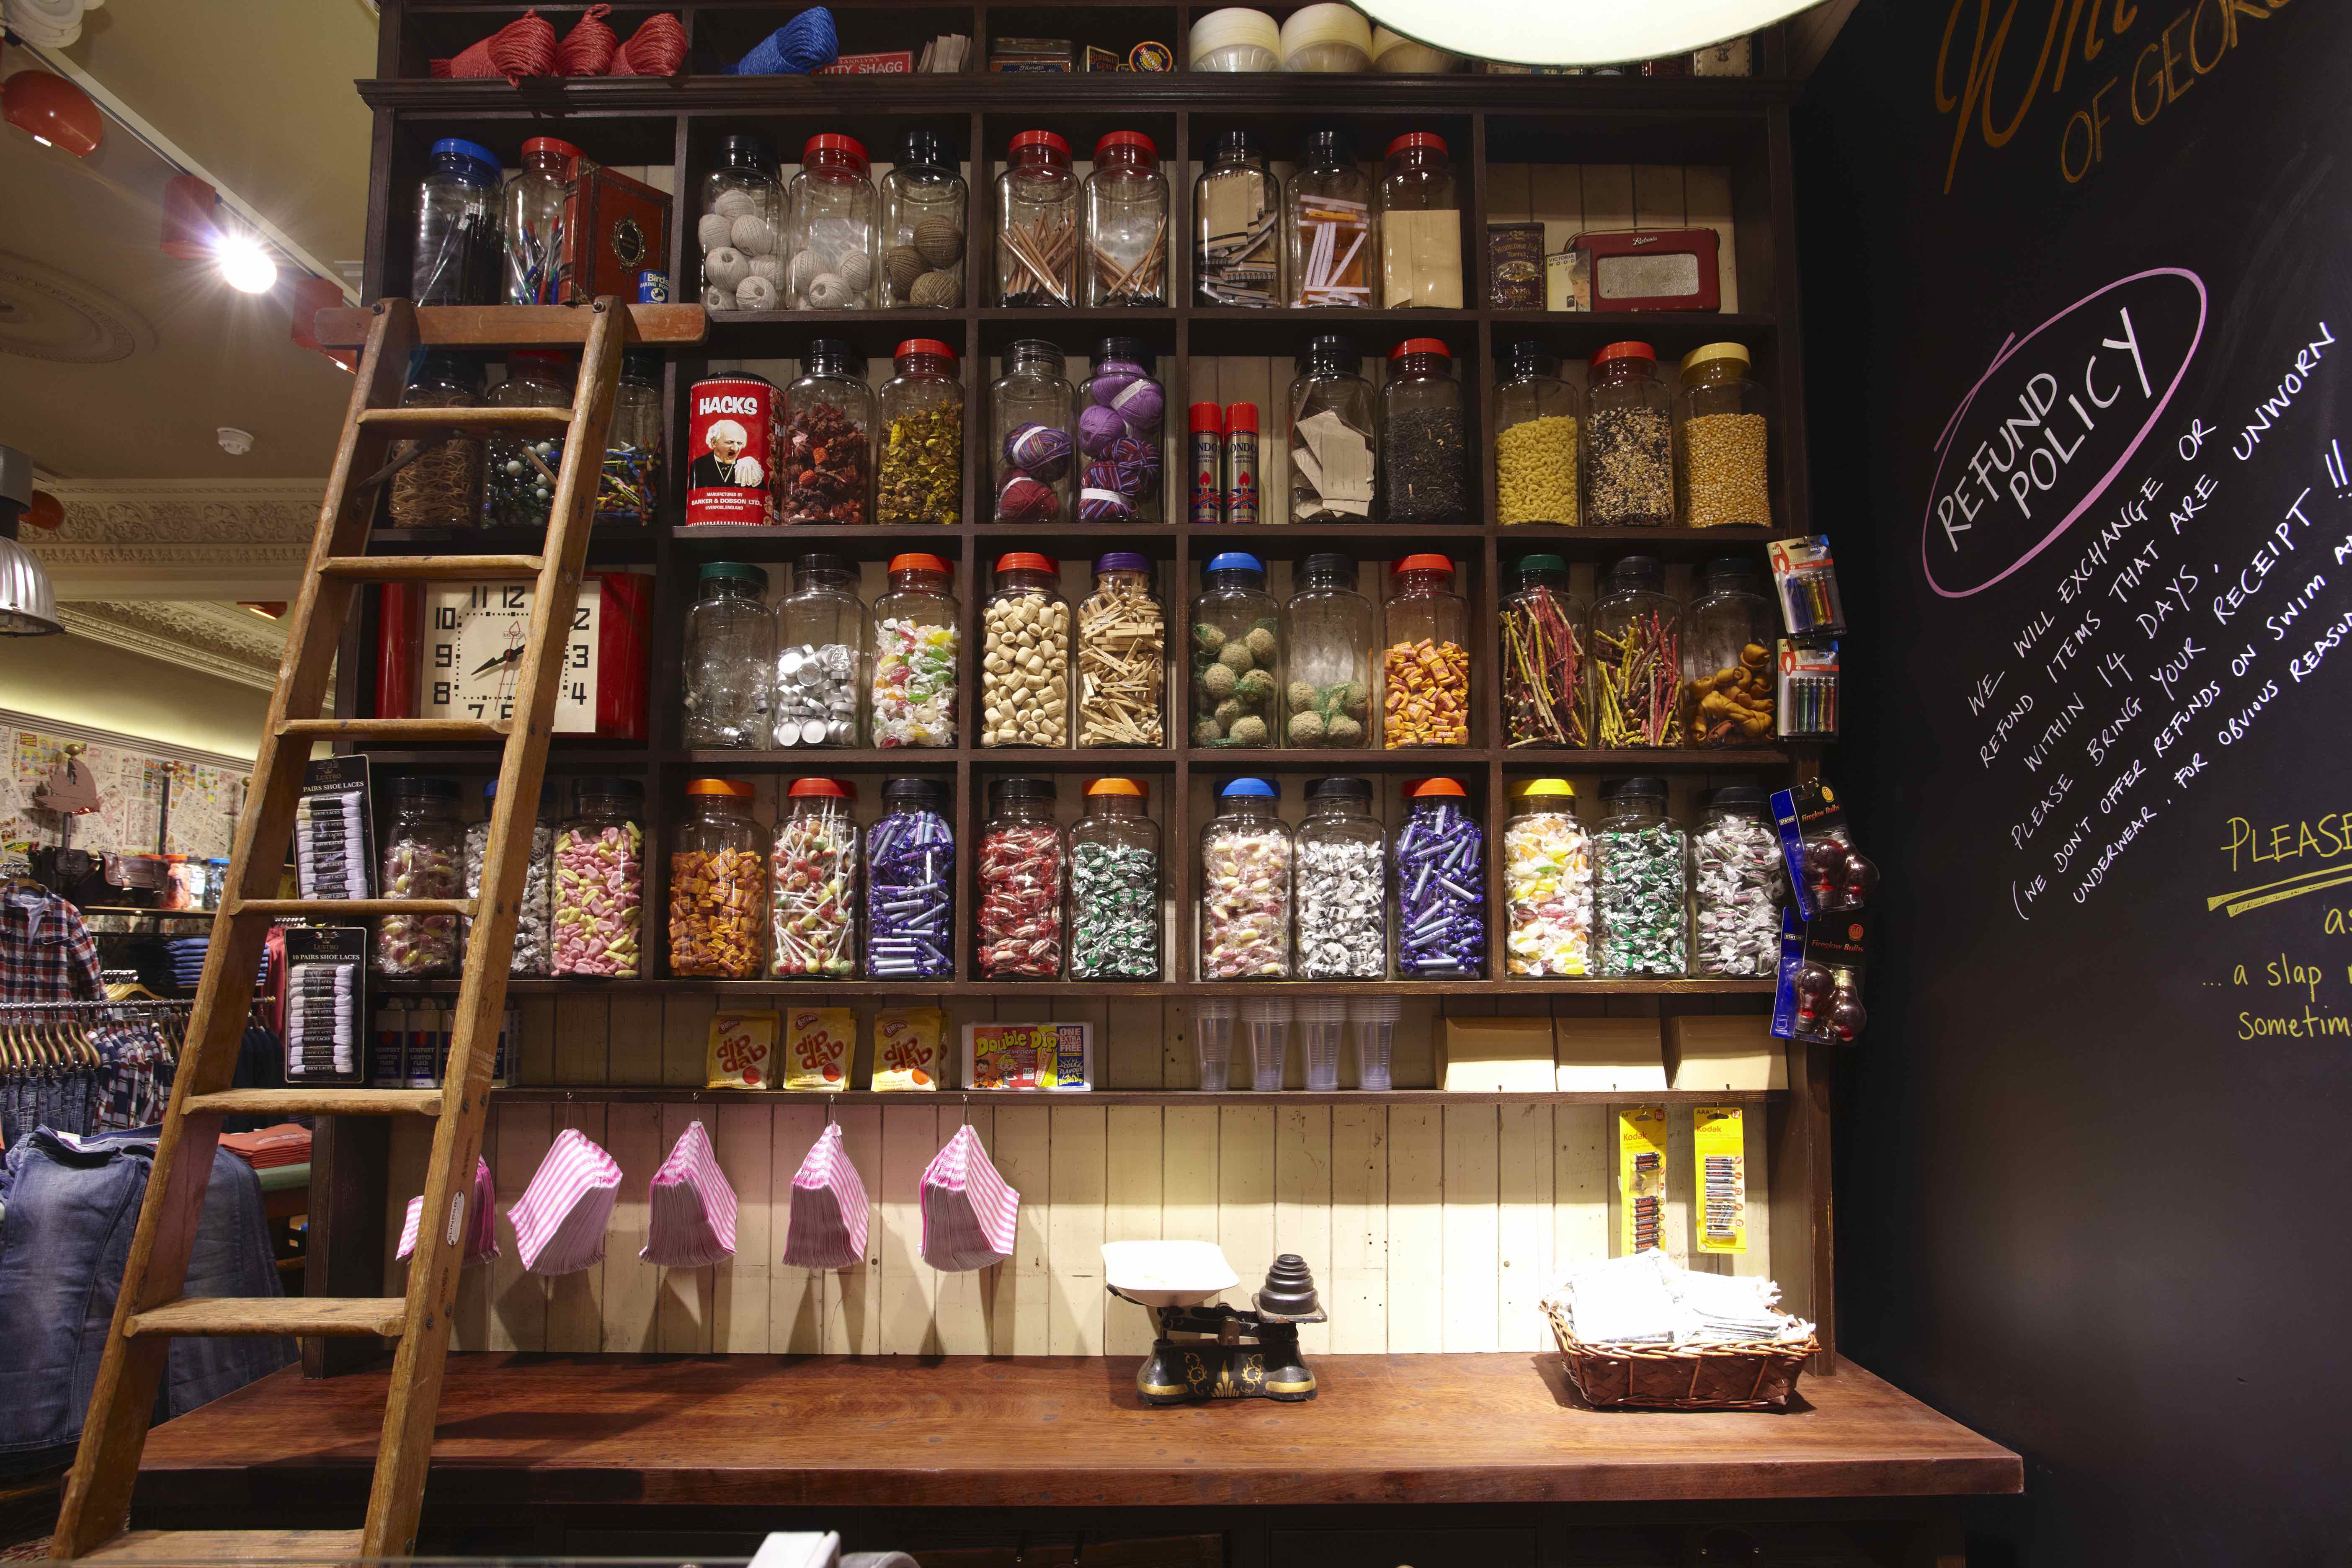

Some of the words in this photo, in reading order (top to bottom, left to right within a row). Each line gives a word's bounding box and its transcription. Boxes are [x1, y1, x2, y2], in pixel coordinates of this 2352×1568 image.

[820, 65, 853, 74] ITTY
[859, 61, 903, 74] SHAGG
[1140, 48, 1164, 72] WALNUT
[2061, 76, 2118, 183] OF
[1633, 236, 1658, 246] Roberts
[1548, 254, 1575, 263] VICTORIA
[699, 395, 758, 415] HACKS
[2009, 307, 2151, 519] POLICY
[1937, 373, 2058, 552] REFUND
[1980, 695, 2033, 769] REFUND
[2046, 610, 2101, 683] ITEMS
[2108, 539, 2160, 603] THAT
[2169, 474, 2218, 535] ARE
[2232, 321, 2336, 461] UNWORN
[1968, 671, 2005, 717] WE
[2013, 611, 2055, 658] WILL
[2057, 477, 2164, 604] EXCHANGE
[2179, 418, 2217, 461] OR
[472, 586, 487, 608] 11
[502, 586, 526, 609] 12
[435, 607, 456, 630] 10
[573, 607, 590, 631] 2
[435, 644, 452, 667] 9
[572, 645, 588, 668] 3
[2011, 774, 2073, 850] PLEASE
[2086, 696, 2143, 766] BRING
[2149, 637, 2205, 701] YOUR
[2213, 487, 2311, 625] RECEIPT
[433, 681, 450, 705] 8
[571, 682, 587, 705] 4
[2024, 693, 2085, 773] WITHIN
[2097, 652, 2133, 688] 14
[2053, 816, 2092, 873] DON'T
[2100, 759, 2147, 815] OFFER
[2154, 680, 2221, 758] REFUNDS
[2231, 644, 2257, 677] ON
[2266, 574, 2326, 641] SWIM
[2174, 753, 2208, 789] FOR
[2218, 679, 2279, 745] OBVIOUS
[1823, 789, 1831, 798] 60
[1801, 810, 1825, 823] Fireglow
[1825, 804, 1841, 815] Bulbs
[1850, 926, 1861, 935] 60
[1811, 939, 1843, 951] Fireglow
[1844, 943, 1864, 952] Bulbs
[2267, 953, 2322, 1003] slap
[717, 1035, 750, 1059] dip
[796, 1030, 828, 1055] dip
[802, 1040, 844, 1069] dab
[884, 1037, 918, 1061] dip
[975, 1030, 1027, 1058] Double
[1029, 1031, 1057, 1053] Dip
[722, 1044, 767, 1073] dab
[890, 1047, 933, 1073] dab
[1059, 1066, 1083, 1075] FLAVOUR
[1623, 1131, 1648, 1141] Kodak
[448, 1196, 459, 1241] SLINGSBY
